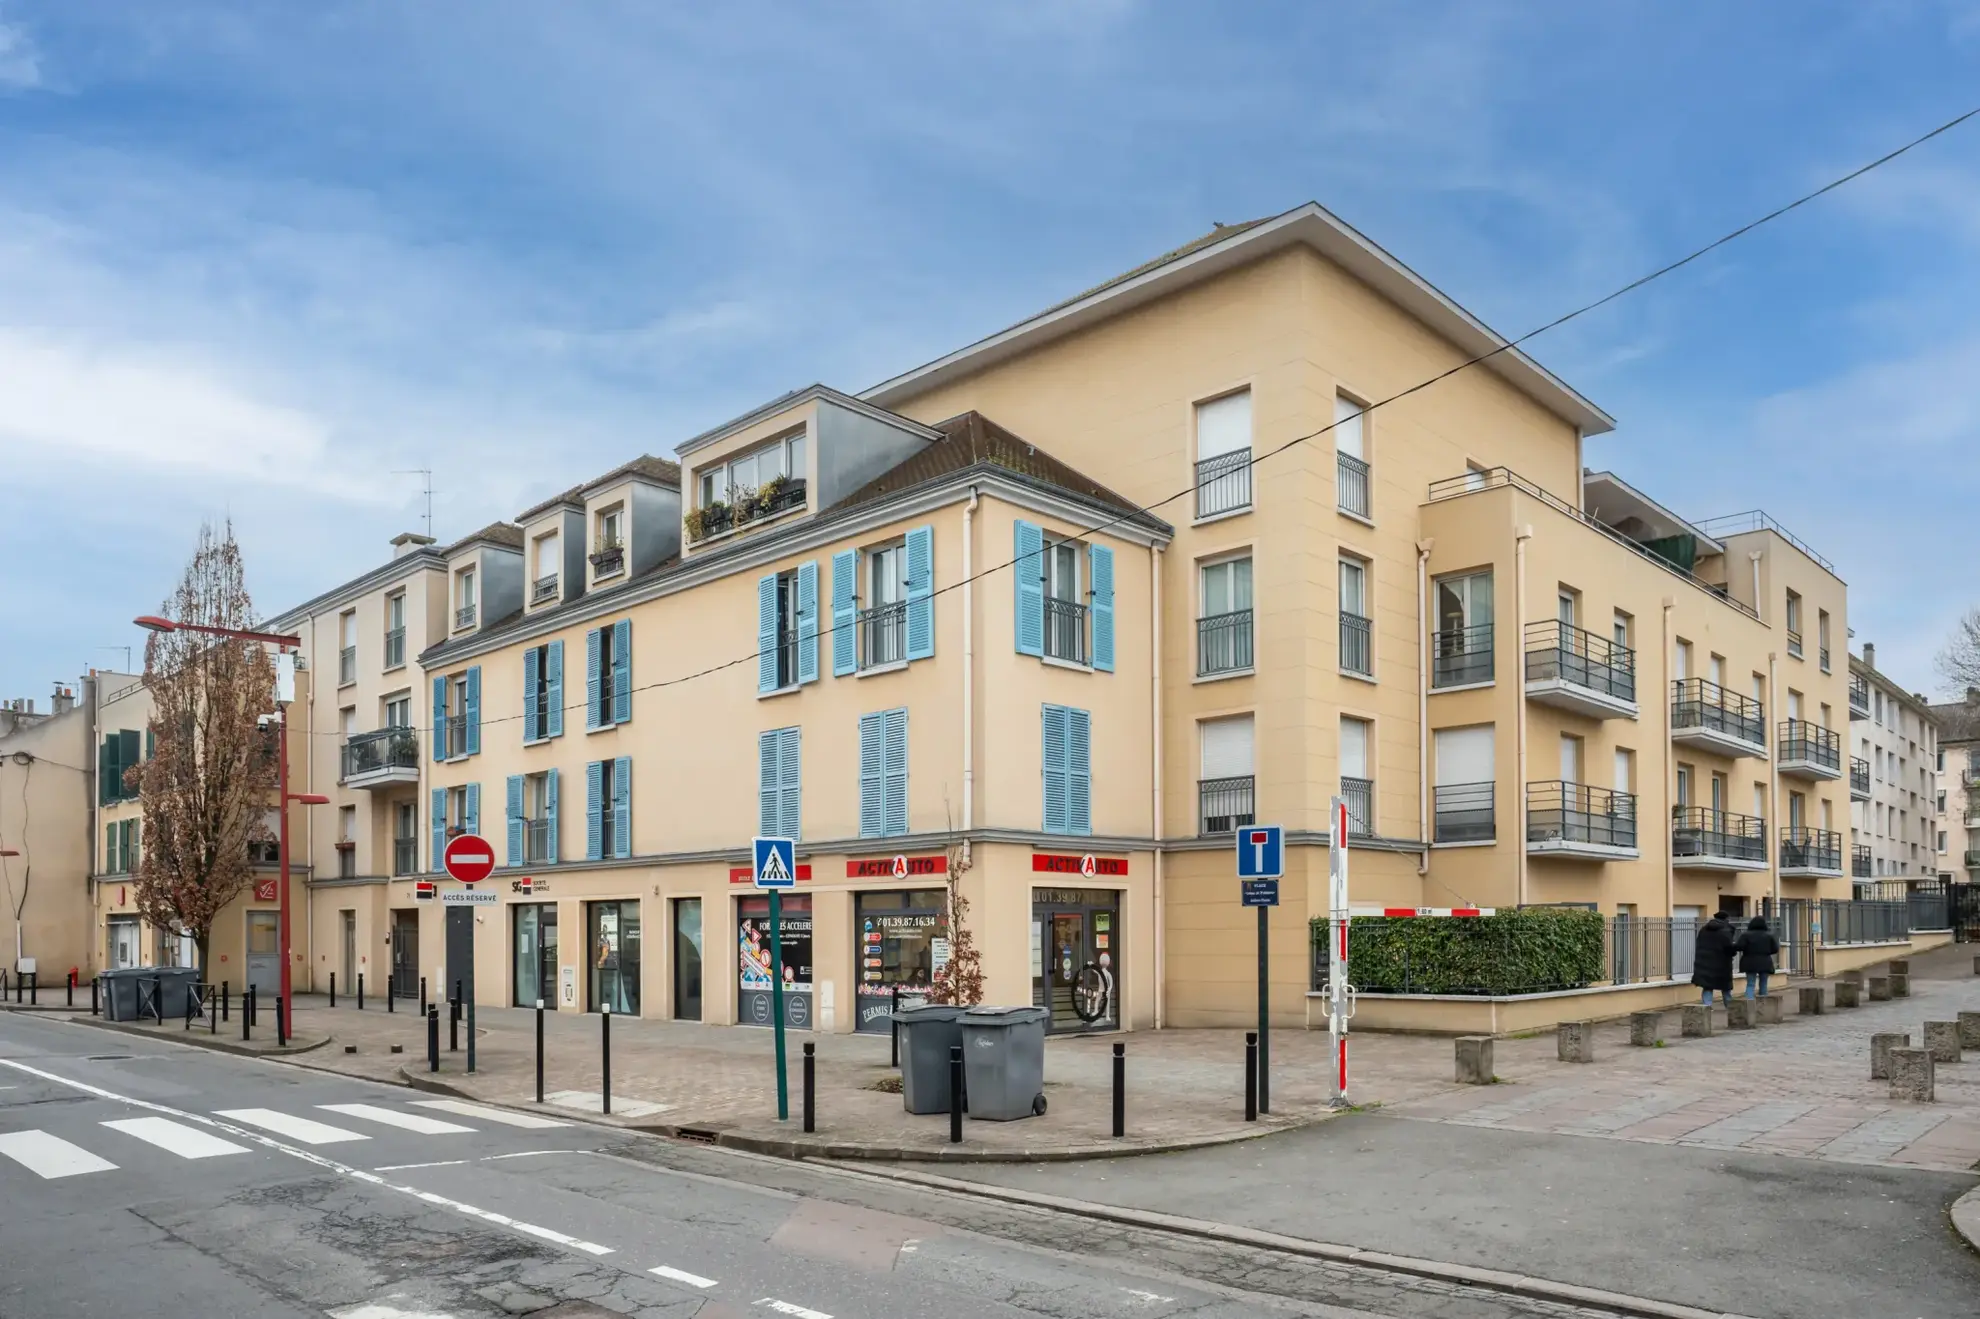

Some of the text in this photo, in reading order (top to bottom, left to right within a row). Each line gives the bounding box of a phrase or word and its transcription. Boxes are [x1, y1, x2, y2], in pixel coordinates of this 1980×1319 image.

[512, 880, 522, 893] SG
[466, 893, 497, 902] RÉSERVÉ
[882, 917, 936, 927] 01.39.87.16.34
[863, 1005, 889, 1020] PERMIS
